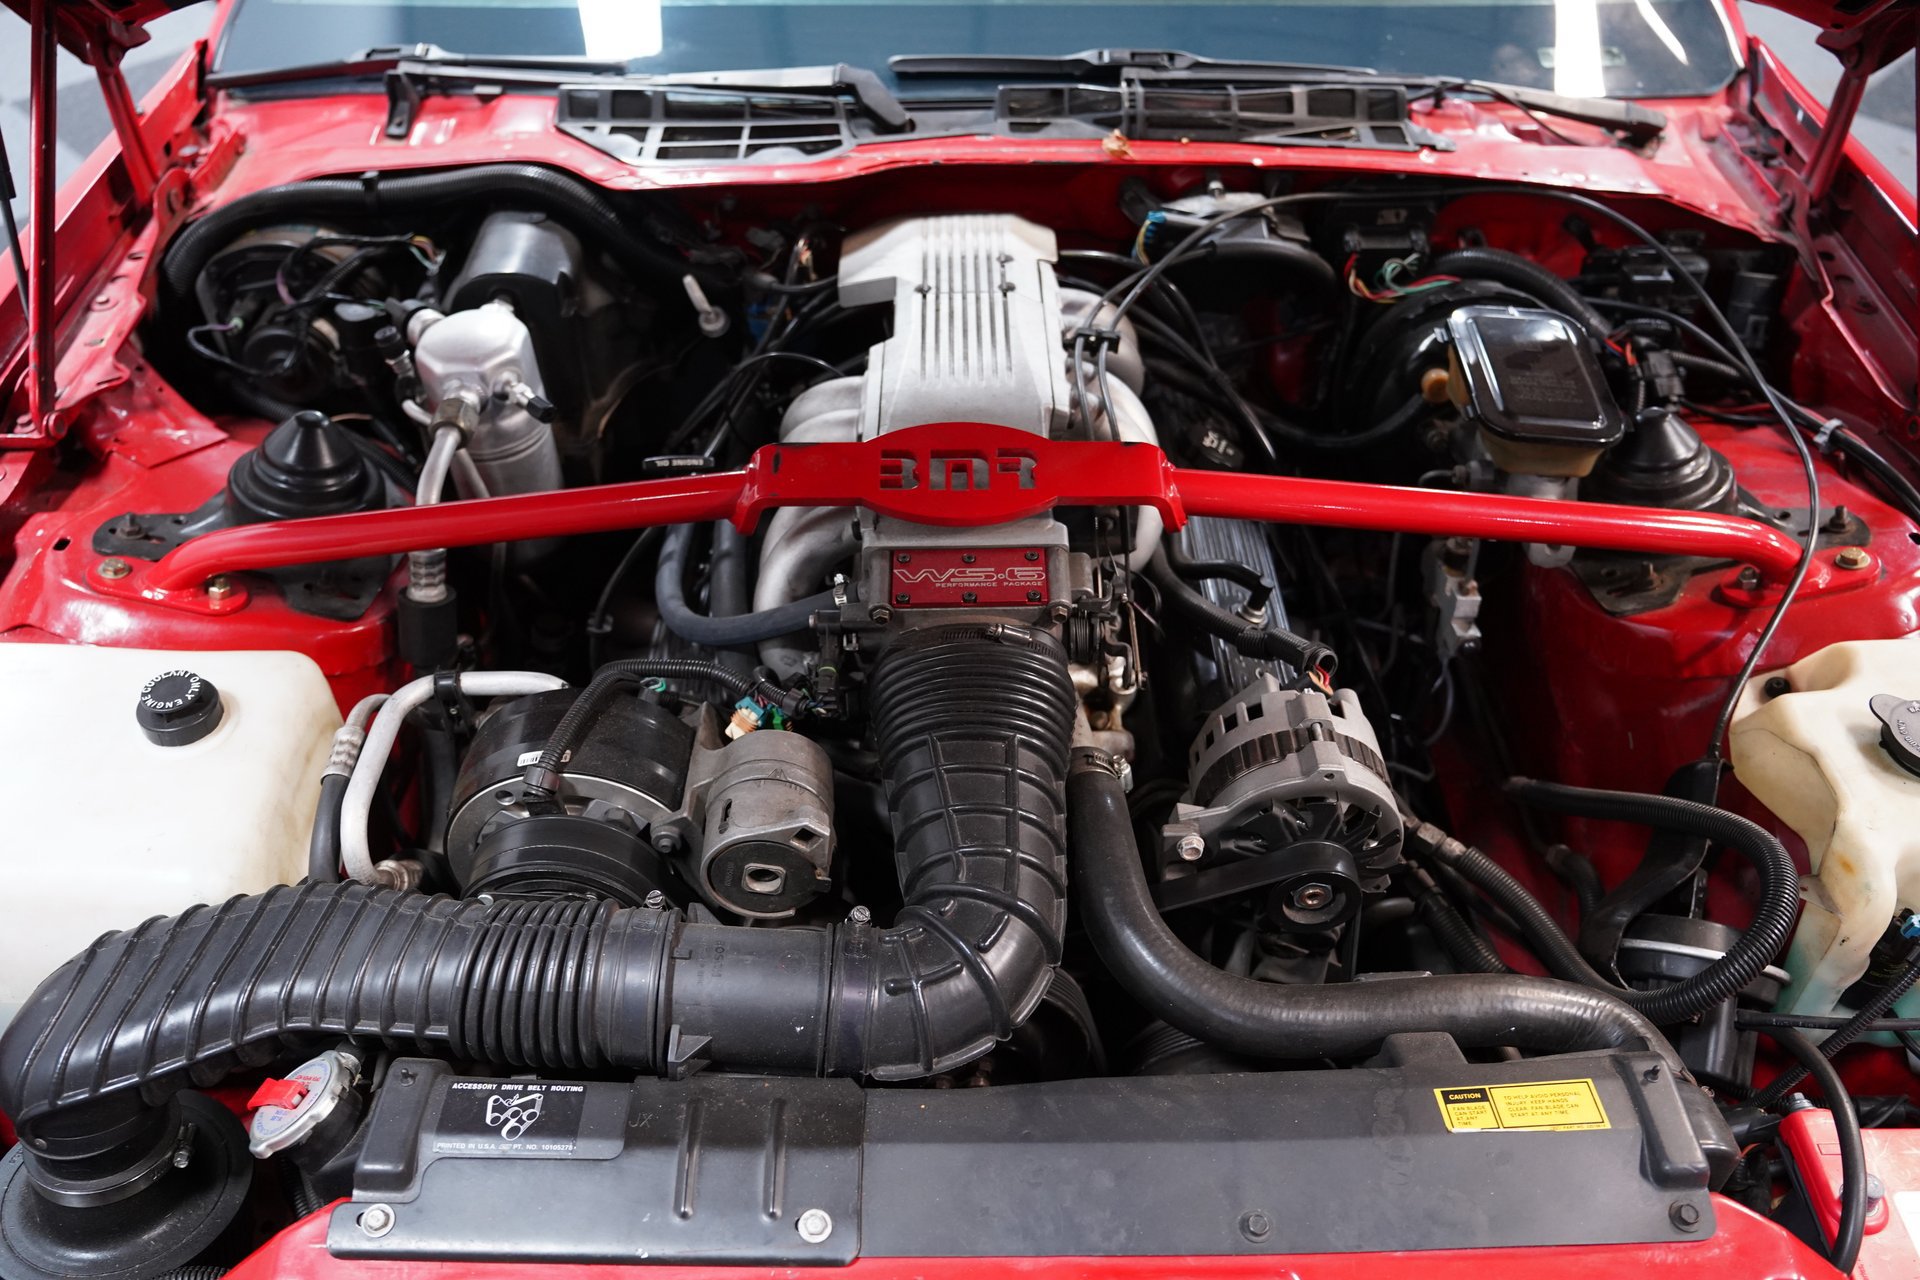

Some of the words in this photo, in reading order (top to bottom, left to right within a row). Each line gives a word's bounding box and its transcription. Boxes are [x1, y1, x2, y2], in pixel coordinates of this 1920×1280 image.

[879, 448, 1038, 491] BMR
[142, 669, 191, 694] COOLANT
[185, 676, 201, 701] ONLY
[141, 694, 184, 709] ENGINE
[451, 1082, 498, 1091] ACCESSORY
[436, 1142, 466, 1150] PRINTED
